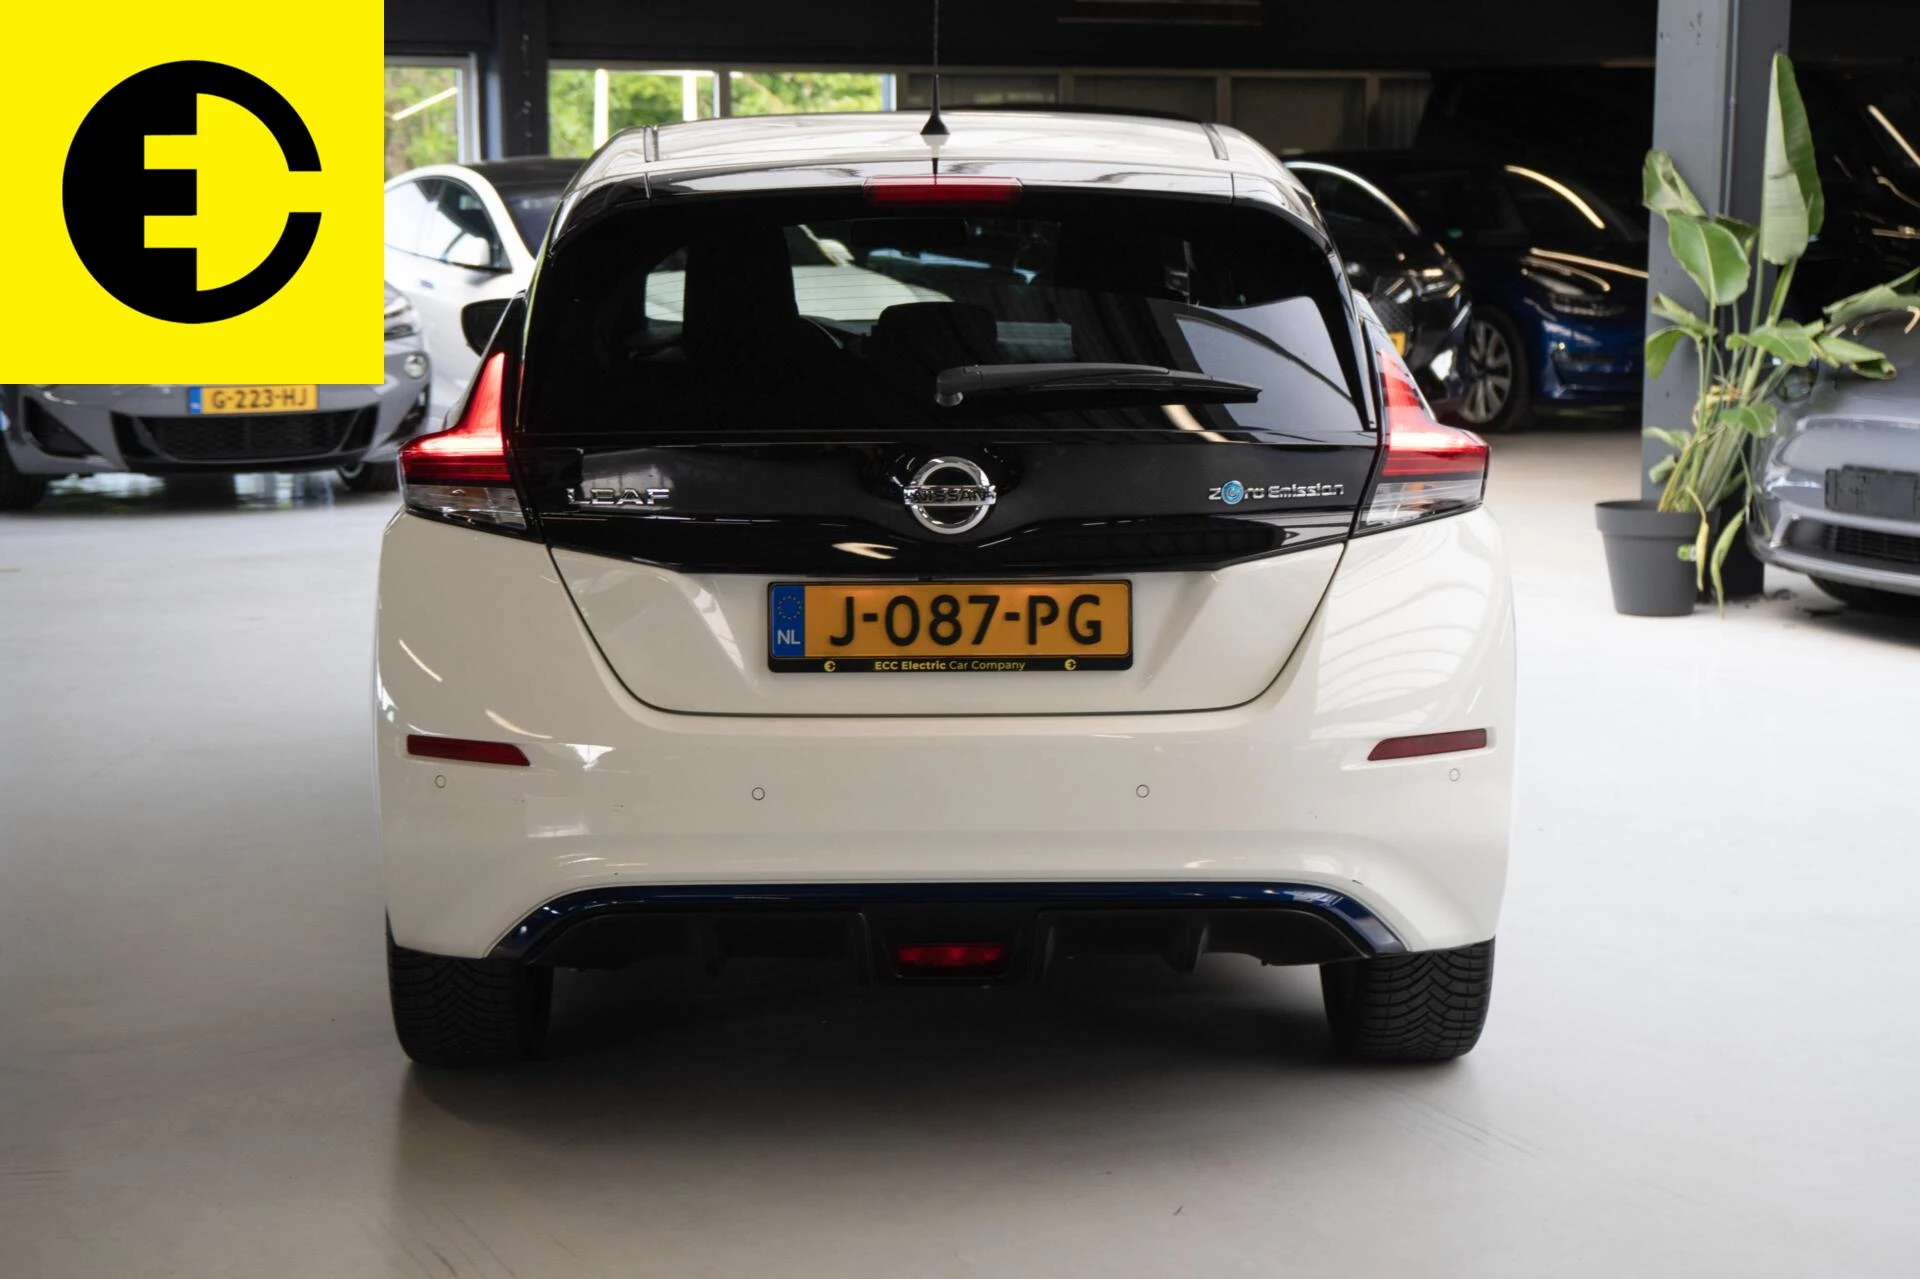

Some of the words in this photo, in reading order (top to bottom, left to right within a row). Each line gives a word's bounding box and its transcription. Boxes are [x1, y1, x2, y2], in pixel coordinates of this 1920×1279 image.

[212, 388, 307, 409] G-223-HJ
[566, 488, 670, 505] LEAF
[909, 487, 985, 503] NISSAN
[1268, 483, 1345, 499] Emission
[829, 594, 1102, 647] J-087-PG
[777, 630, 800, 645] NL
[874, 661, 898, 670] ECC
[901, 660, 946, 670] Electric
[949, 661, 968, 670] Car
[971, 661, 1026, 671] Company
